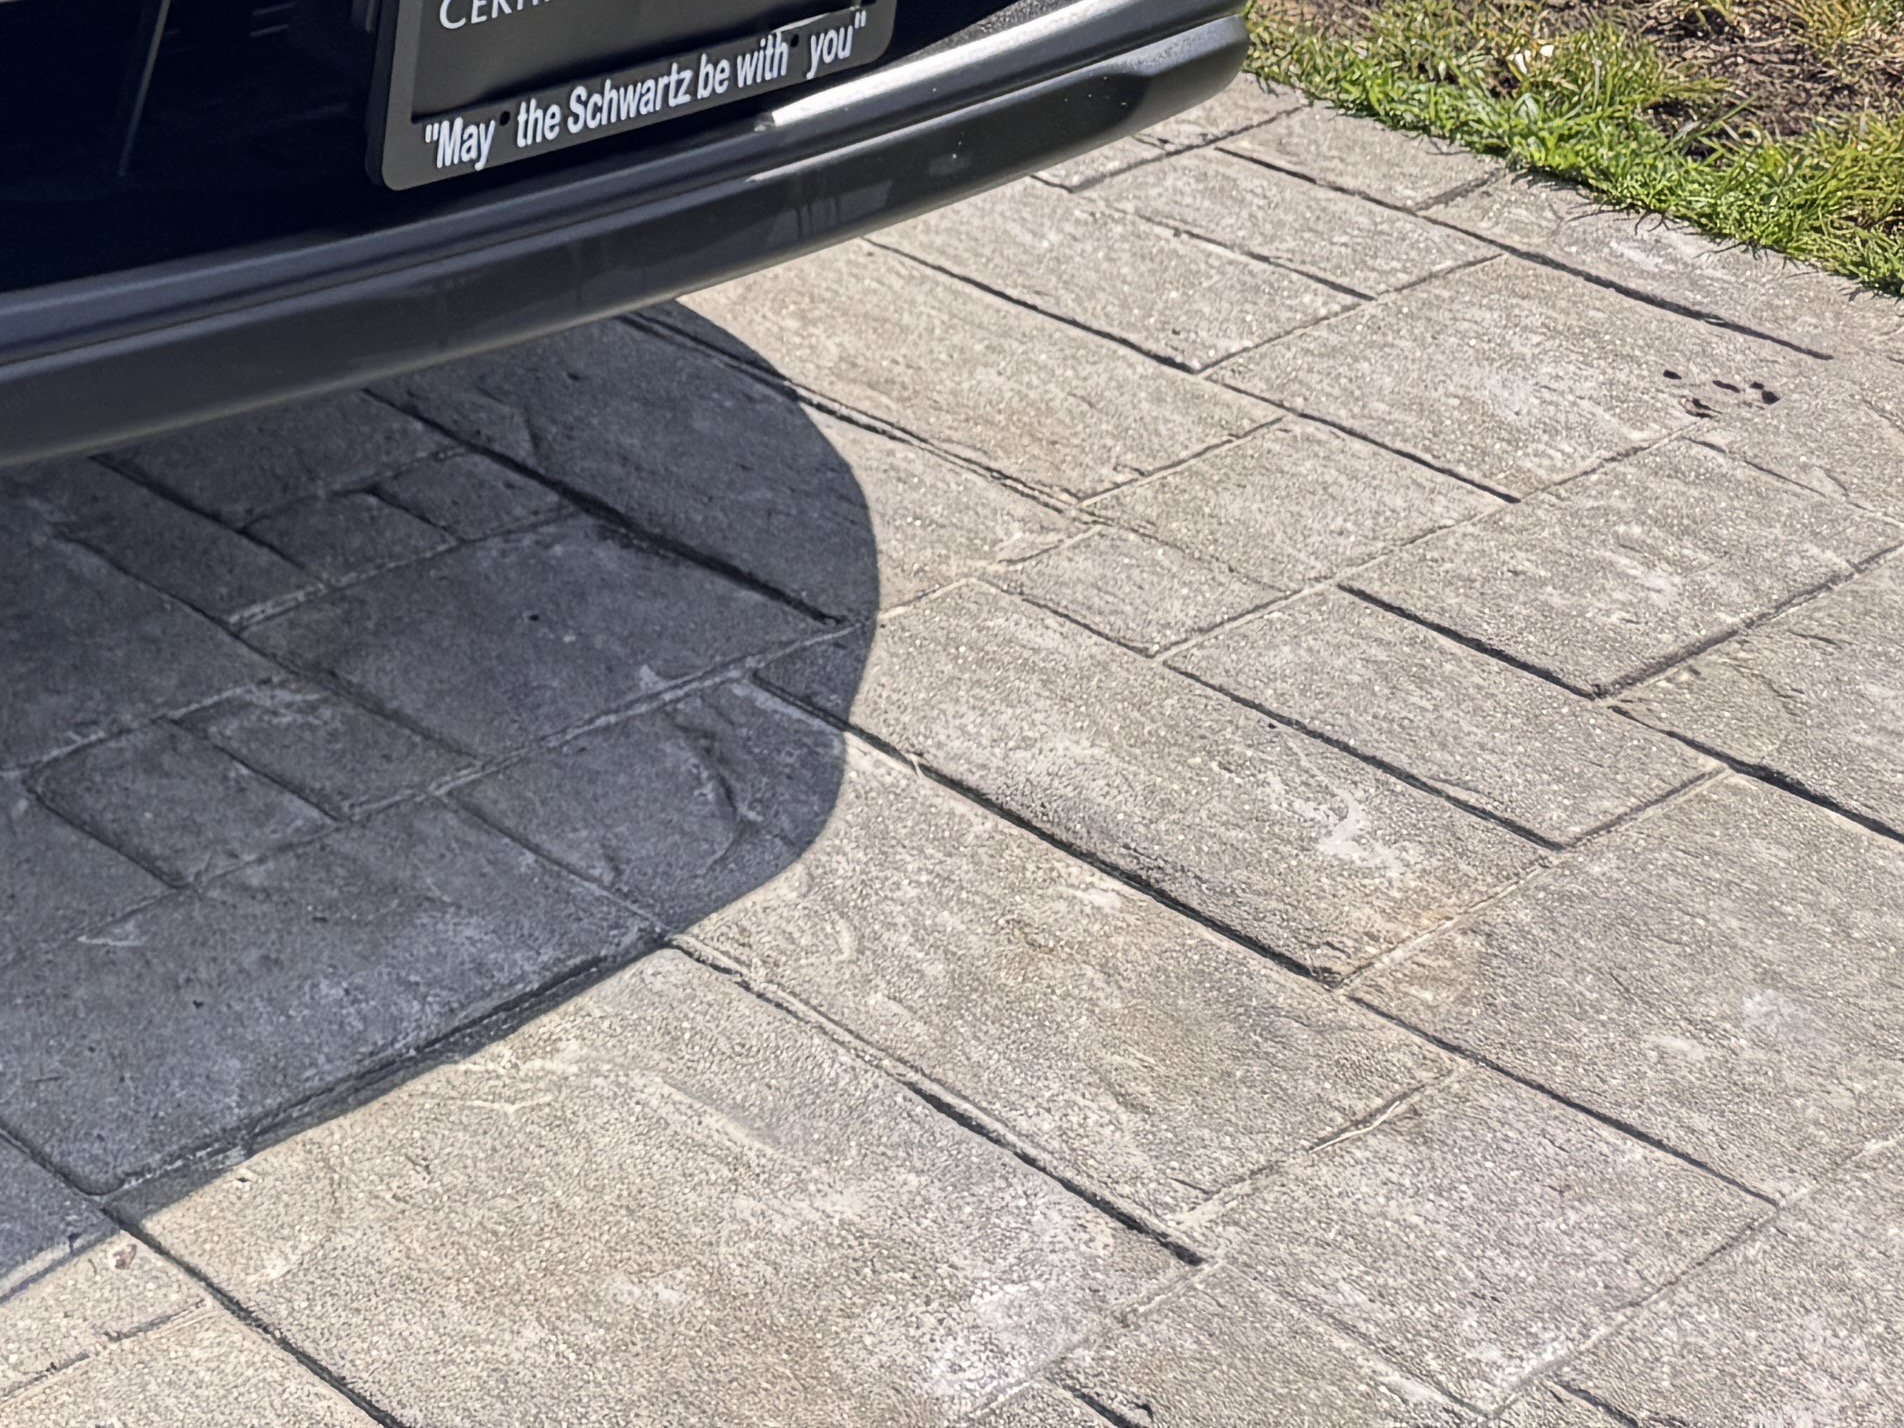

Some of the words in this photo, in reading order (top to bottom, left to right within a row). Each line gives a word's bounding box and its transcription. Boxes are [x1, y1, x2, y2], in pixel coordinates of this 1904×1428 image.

[424, 117, 496, 172] "May
[517, 98, 562, 148] the
[567, 62, 694, 135] Schwartz
[697, 53, 731, 99] be
[736, 30, 789, 88] with
[805, 9, 867, 81] you"
